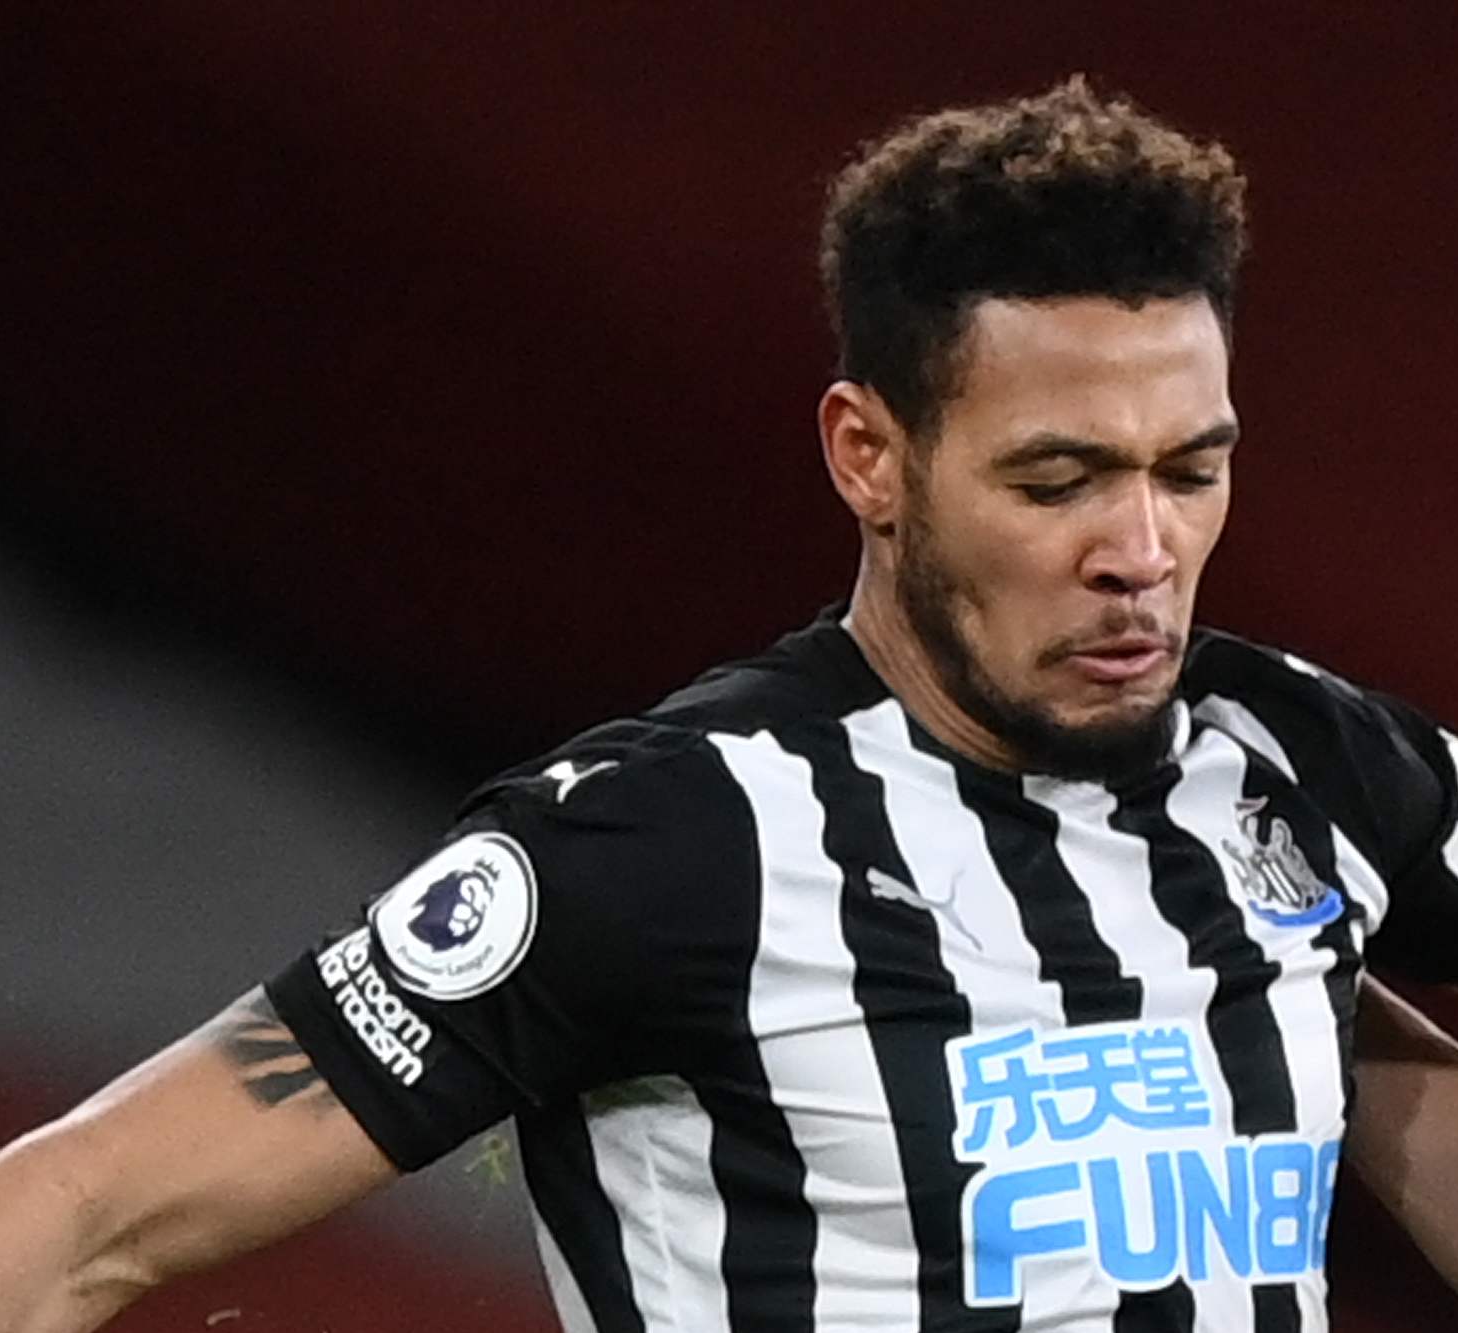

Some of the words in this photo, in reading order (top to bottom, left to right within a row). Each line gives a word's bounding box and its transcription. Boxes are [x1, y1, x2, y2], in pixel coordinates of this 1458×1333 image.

[334, 983, 424, 1087] racism
[356, 962, 433, 1053] room
[959, 1026, 1212, 1153] 乐天堂
